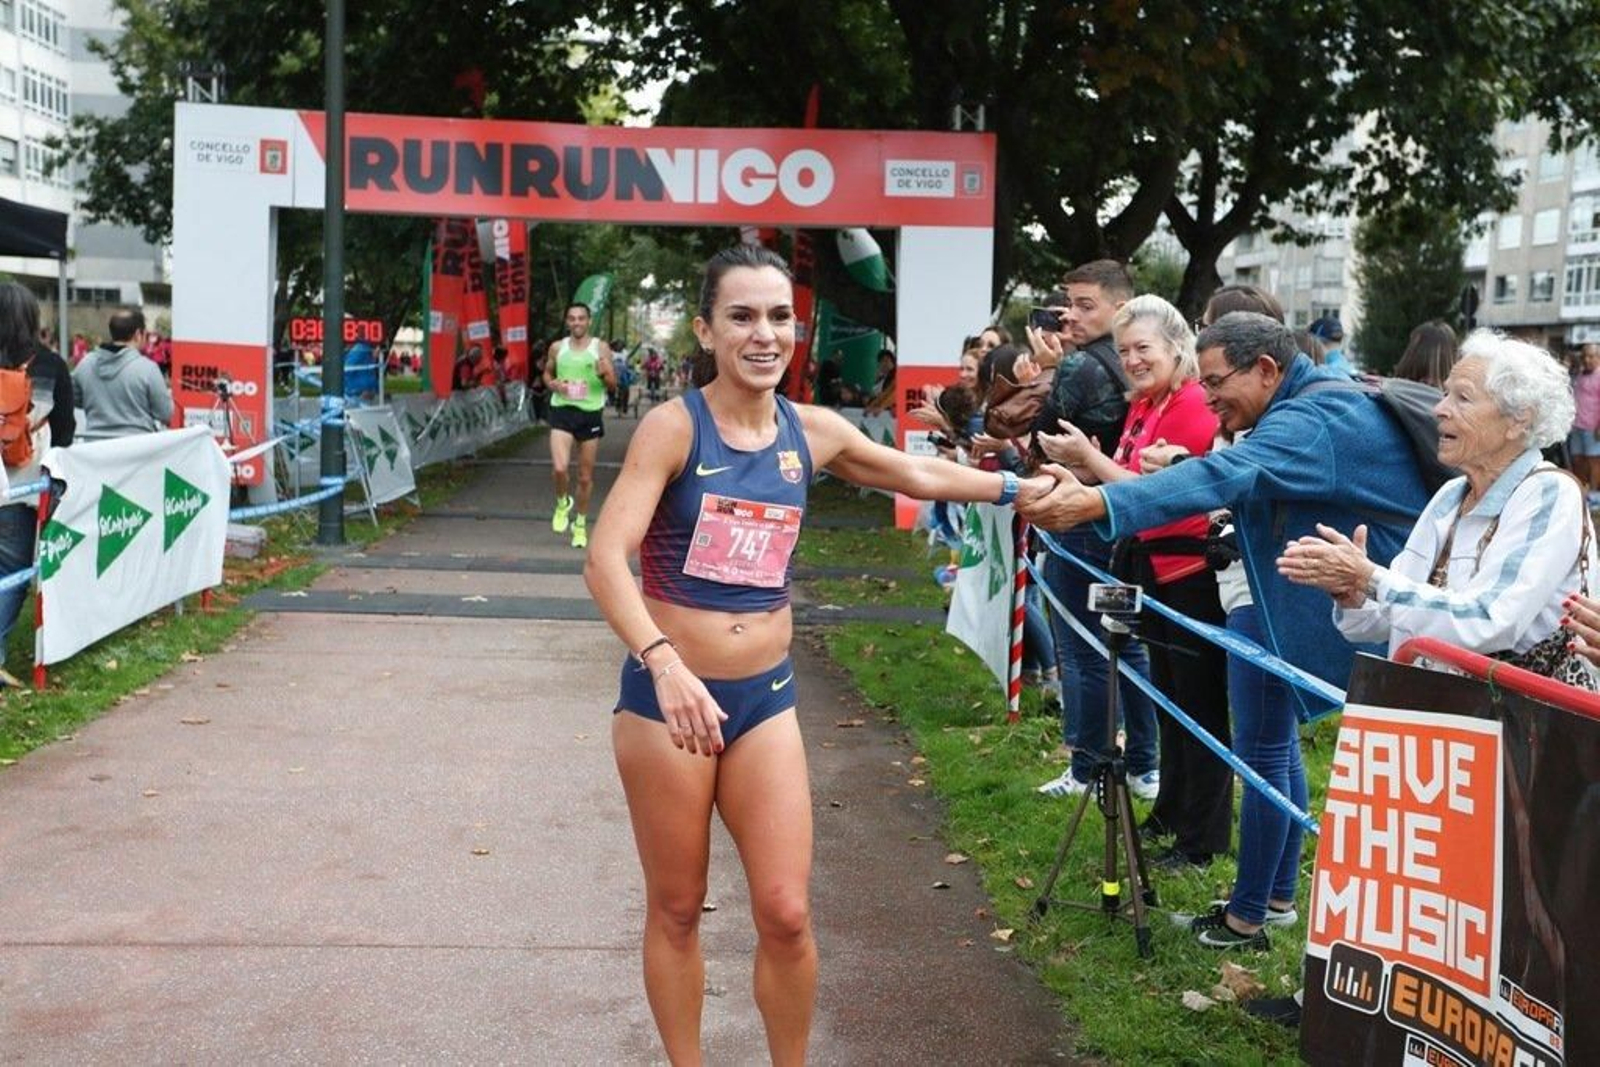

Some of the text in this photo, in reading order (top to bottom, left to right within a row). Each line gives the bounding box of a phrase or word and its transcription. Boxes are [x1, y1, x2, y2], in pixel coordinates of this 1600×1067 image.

[189, 140, 251, 154] CONCELLO
[197, 152, 243, 165] DE VIGO
[890, 167, 951, 178] CONCELLO
[898, 179, 942, 190] DE VIGO
[182, 365, 219, 379] RUN
[727, 526, 771, 563] 747
[1328, 726, 1476, 816] SAVE
[1324, 798, 1443, 884] THE
[1314, 868, 1487, 982] MUSIC
